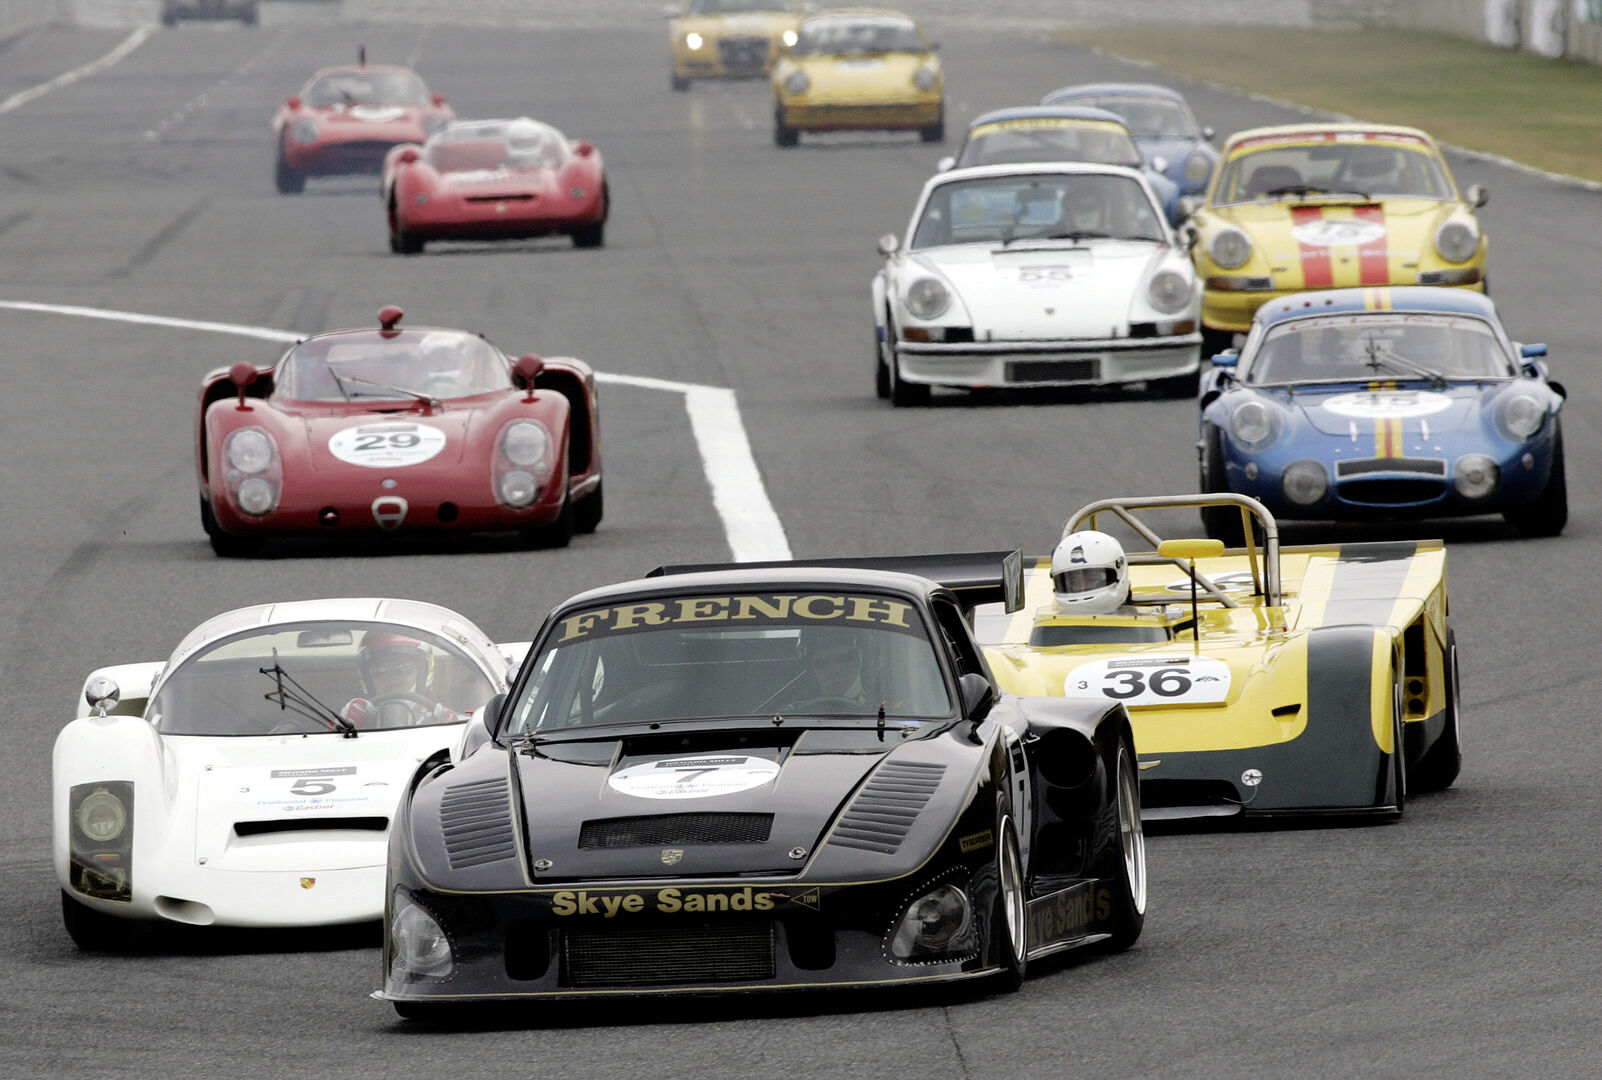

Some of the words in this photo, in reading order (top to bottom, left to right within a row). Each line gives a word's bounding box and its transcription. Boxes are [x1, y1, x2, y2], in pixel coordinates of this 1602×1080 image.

[354, 433, 421, 451] 29
[558, 595, 913, 643] FRENCH
[1077, 680, 1089, 690] 3
[1102, 668, 1192, 699] 36
[675, 767, 720, 783] 7
[289, 778, 337, 796] 5
[295, 803, 335, 811] Castrol
[552, 891, 645, 917] Skye
[657, 887, 776, 912] Sands
[803, 895, 818, 903] TOW
[1027, 904, 1054, 948] kye
[1056, 881, 1111, 935] Sands
